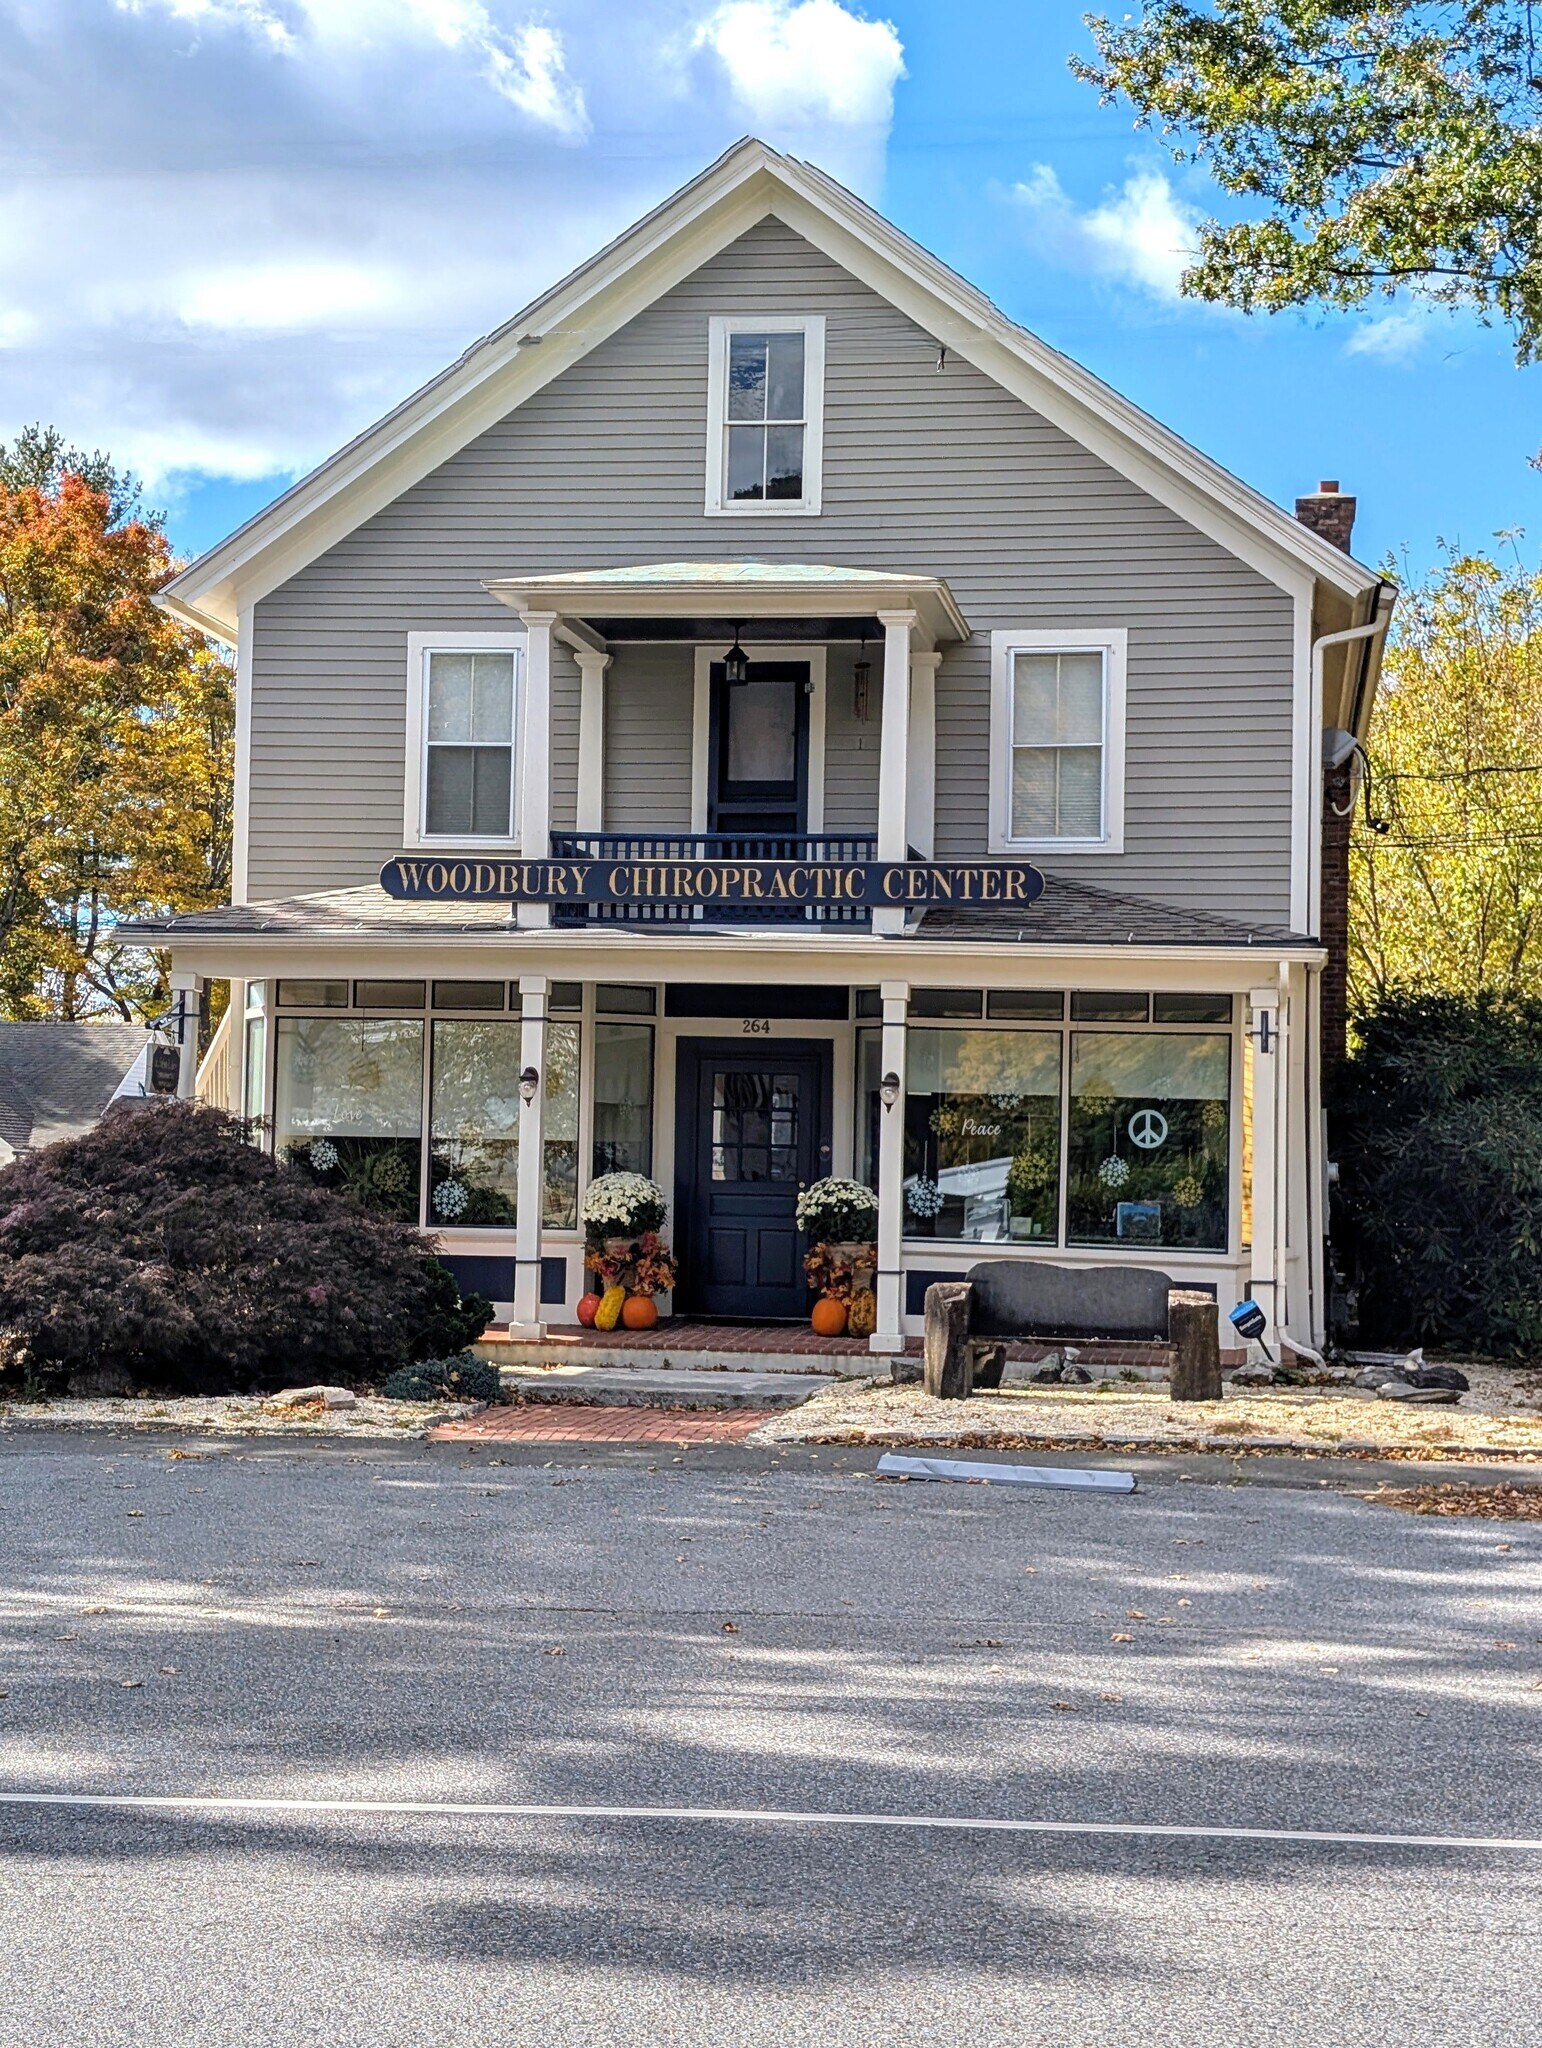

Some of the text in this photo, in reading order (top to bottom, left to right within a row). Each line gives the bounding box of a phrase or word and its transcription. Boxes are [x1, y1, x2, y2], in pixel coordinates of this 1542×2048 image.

[396, 863, 1028, 900] WOODBURY CHIROPRACTIC CENTER
[743, 1019, 770, 1034] 264
[331, 1103, 363, 1124] Love
[961, 1118, 1002, 1136] Peace
